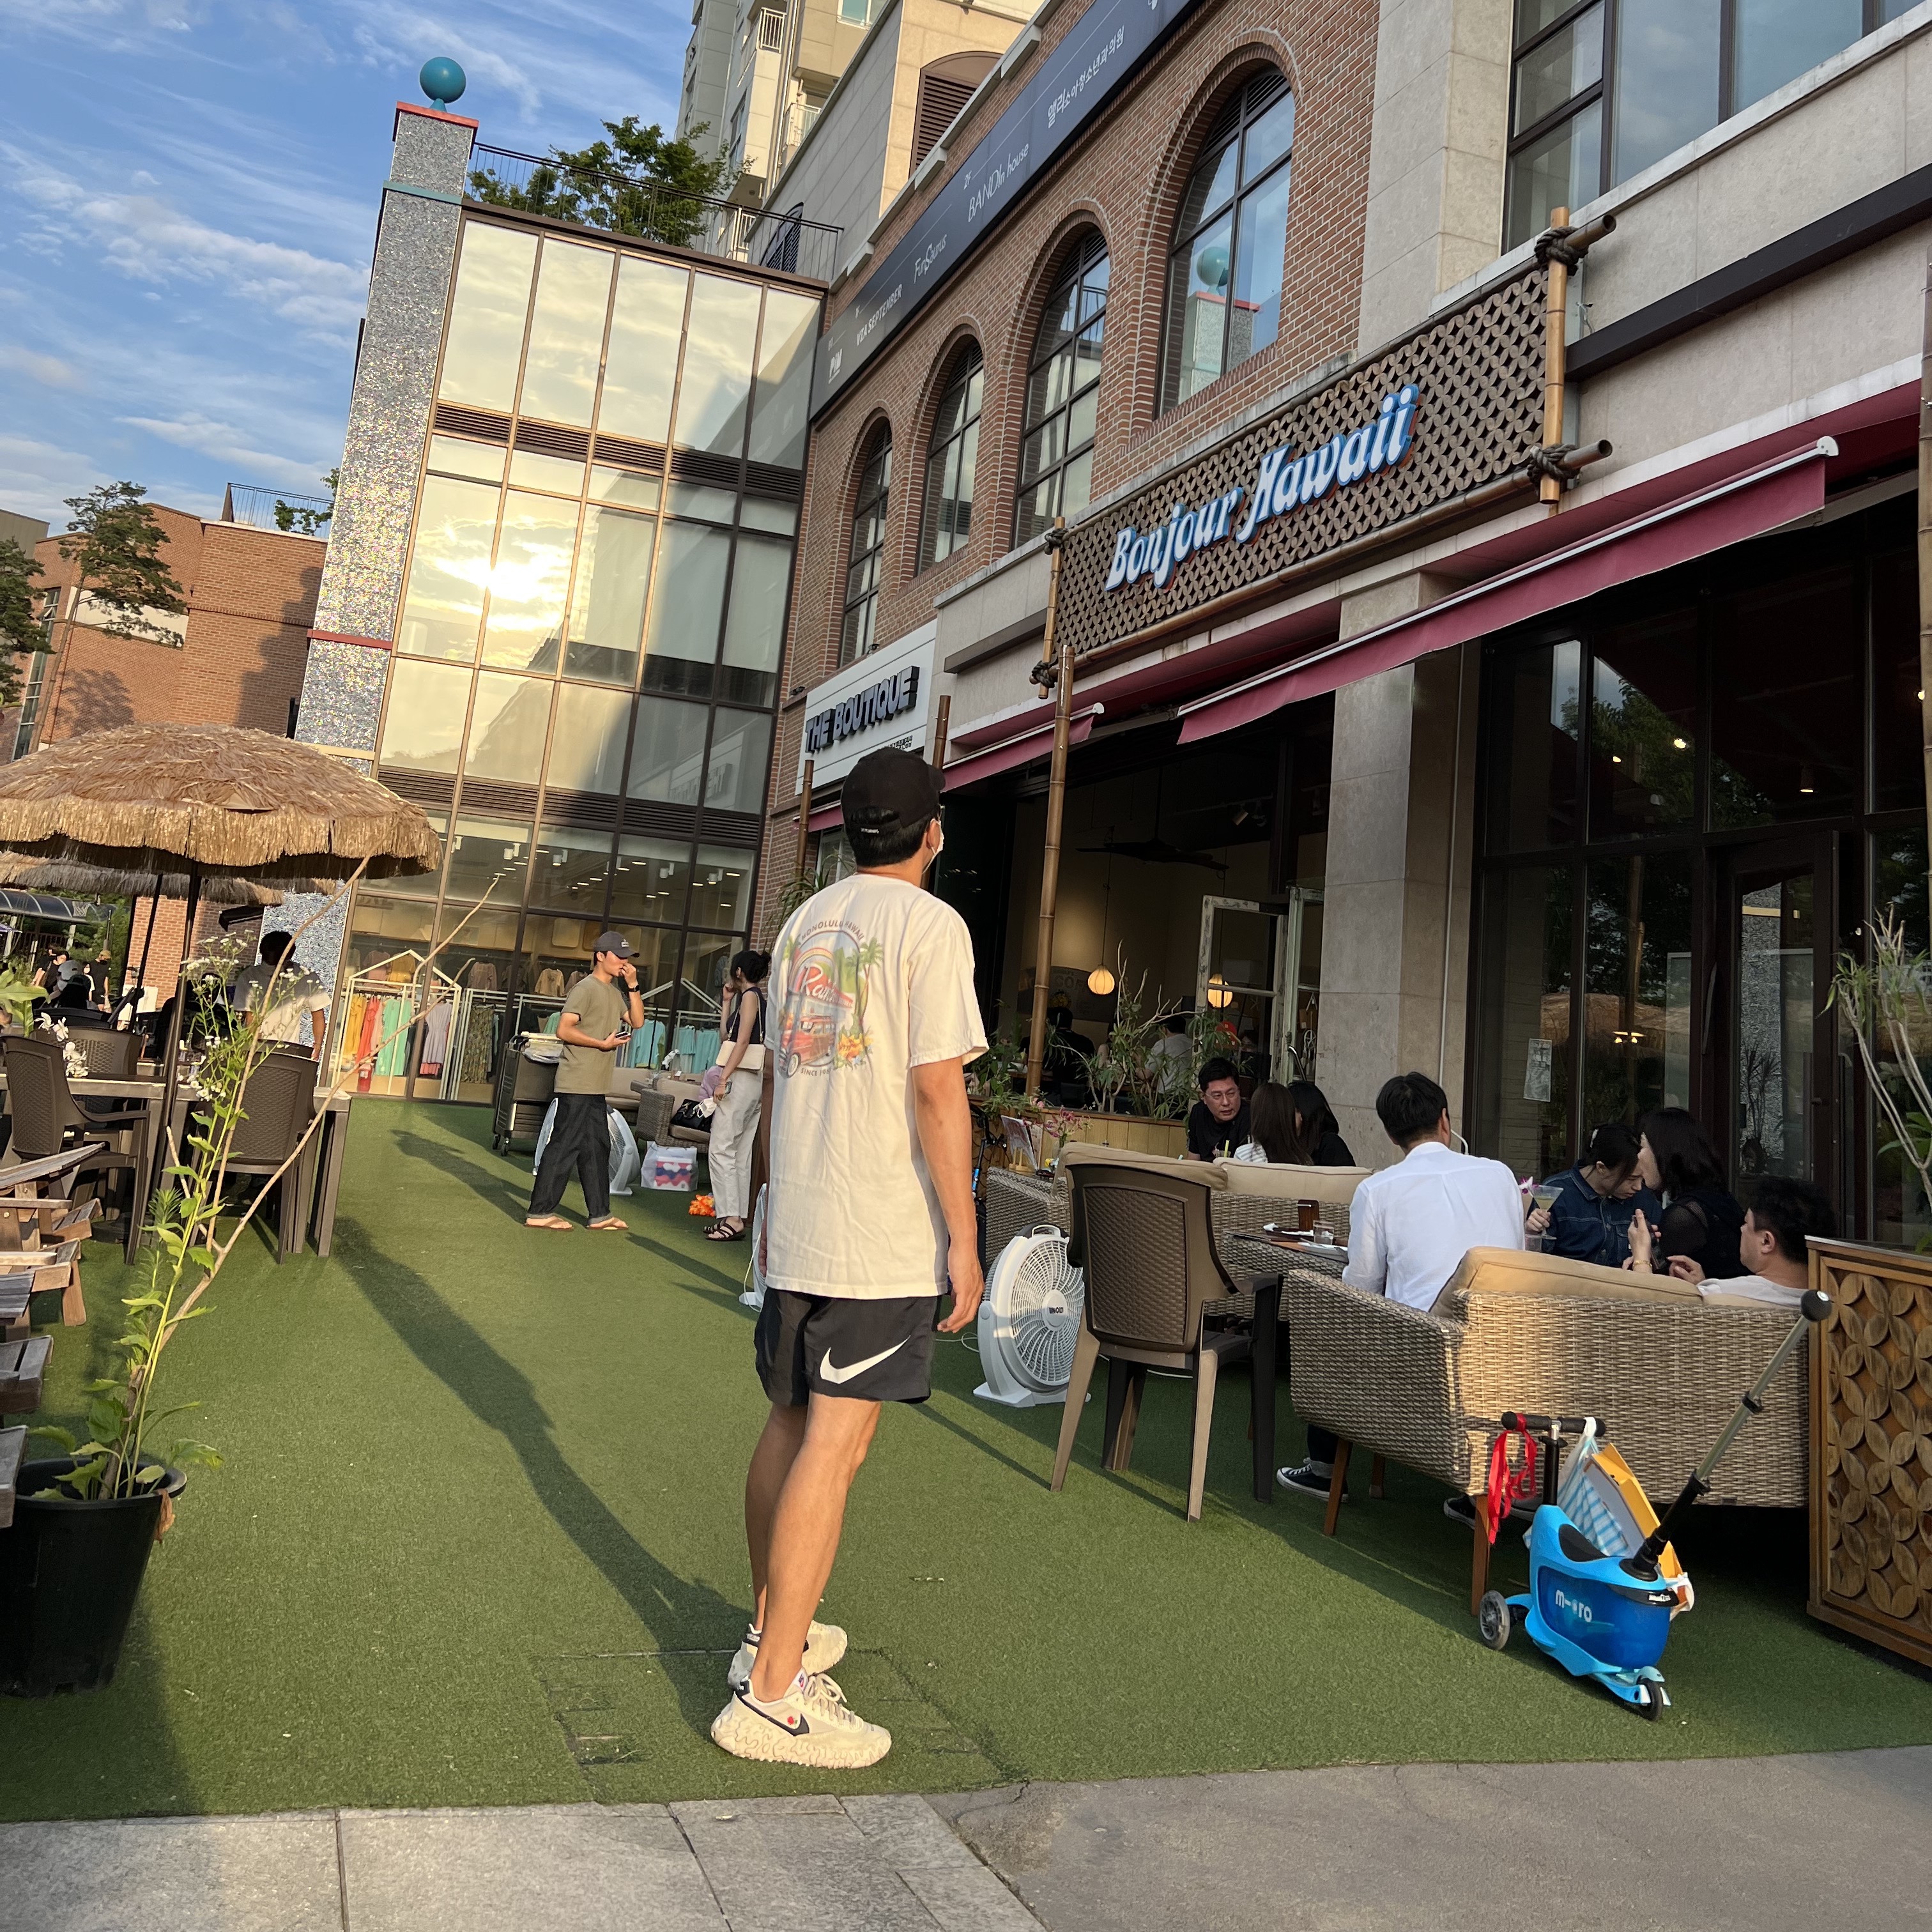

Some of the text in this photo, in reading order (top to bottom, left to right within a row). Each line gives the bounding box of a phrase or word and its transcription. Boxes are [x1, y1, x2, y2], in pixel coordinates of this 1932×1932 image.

[1007, 144, 1029, 178] house
[868, 284, 902, 334] SEPTEMBER
[1105, 383, 1418, 590] Bonjour Hawaii
[805, 665, 920, 753] THE BOUTIQUE
[801, 1068, 818, 1076] SINCE
